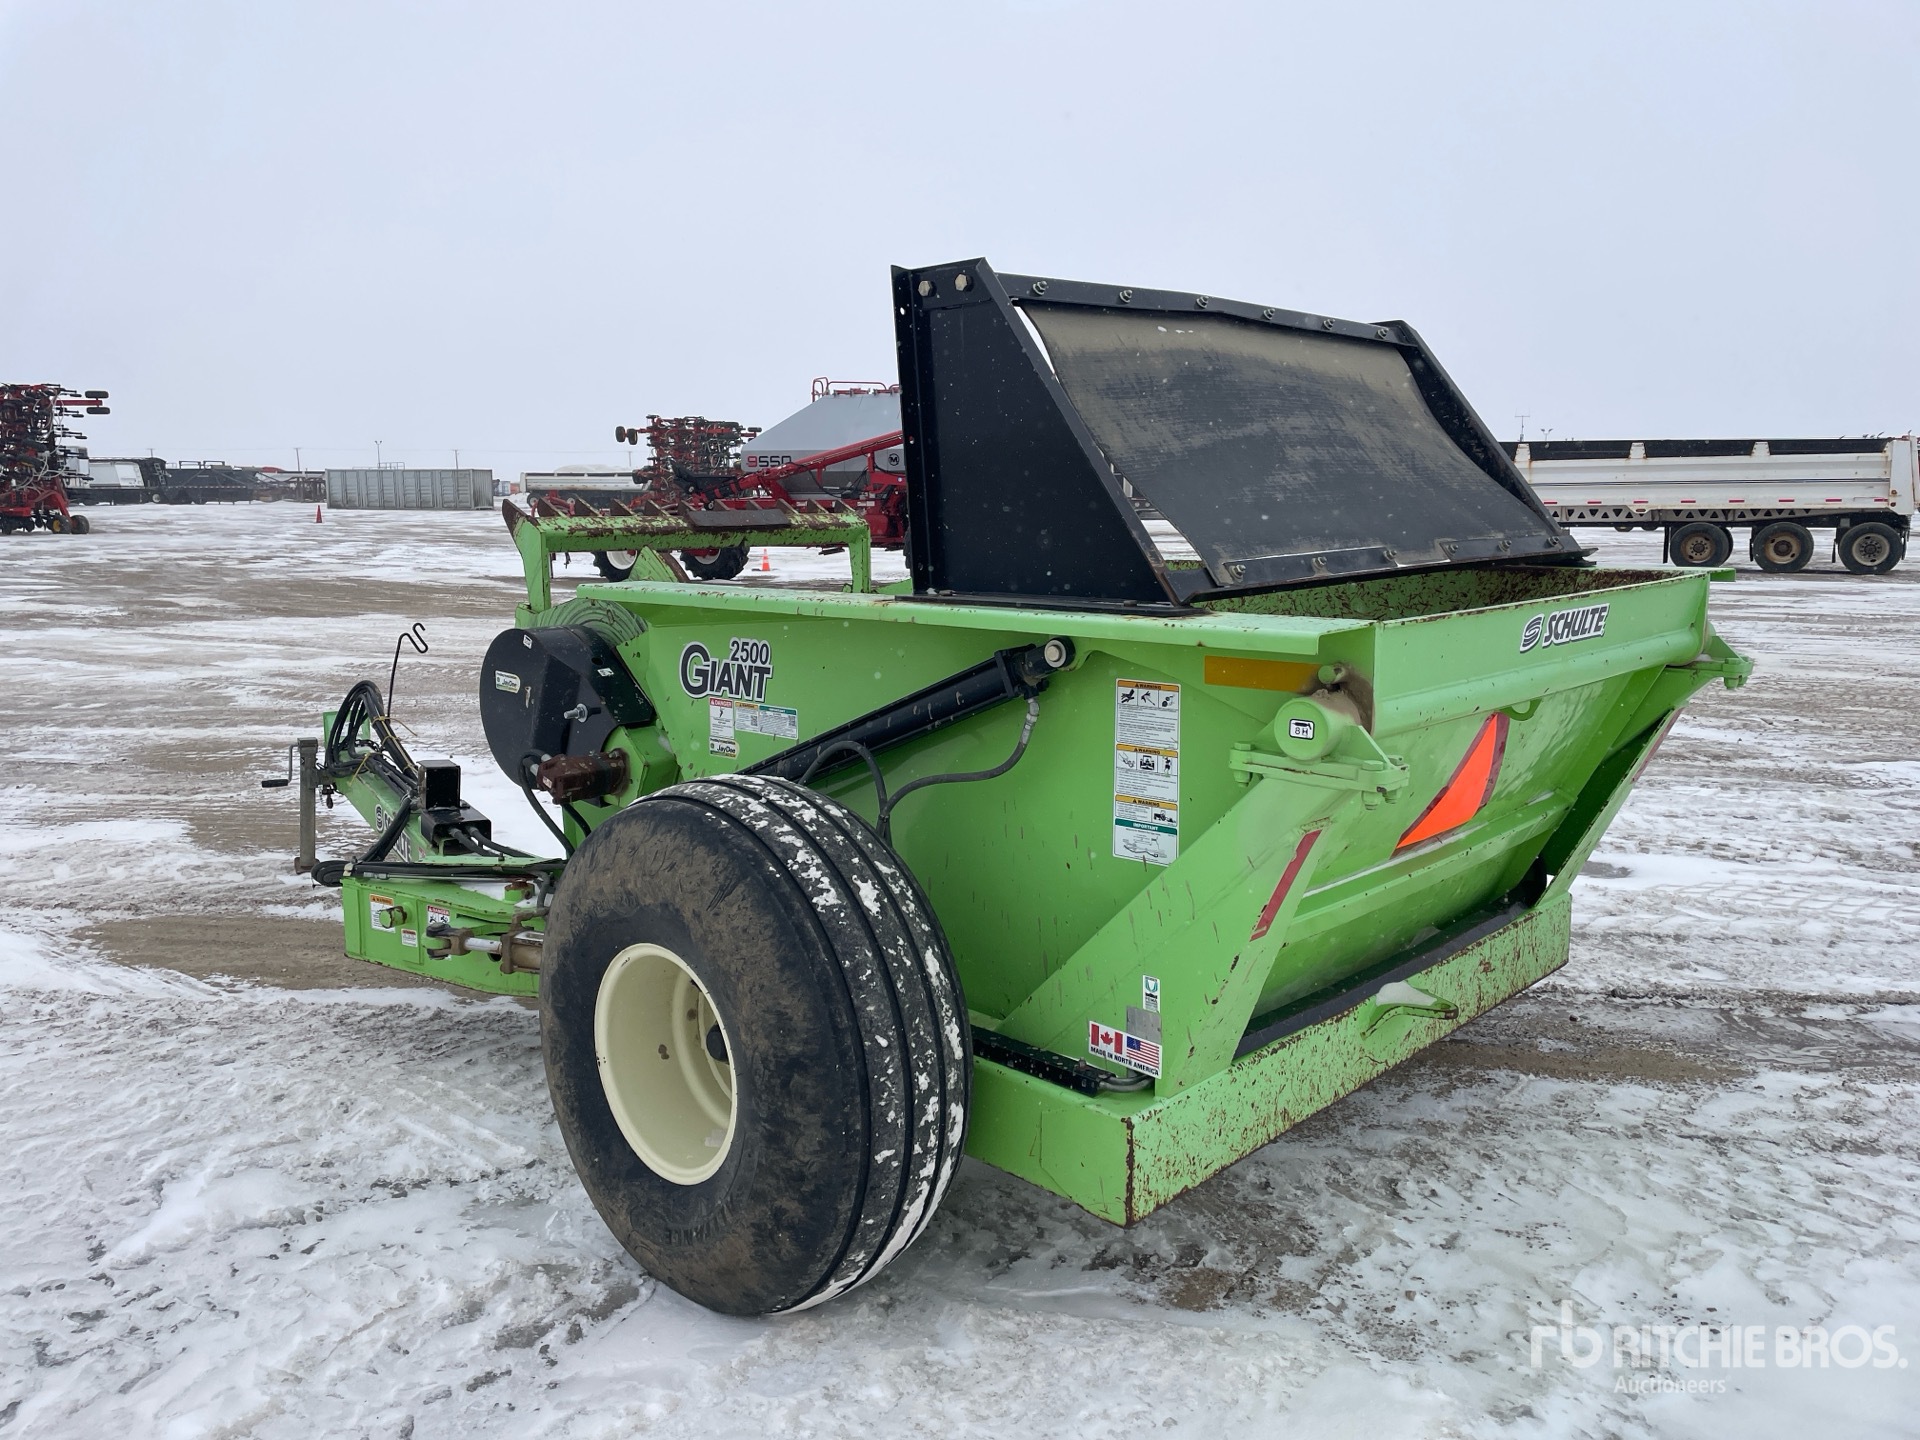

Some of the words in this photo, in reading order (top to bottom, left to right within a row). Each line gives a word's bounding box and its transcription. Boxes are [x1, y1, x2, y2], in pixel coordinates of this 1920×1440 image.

[1543, 606, 1608, 643] SCHULTE
[730, 640, 770, 665] 2500
[681, 644, 771, 698] GIANT
[1294, 727, 1301, 735] 8
[1137, 799, 1160, 807] WARNING
[1132, 823, 1159, 831] IMPORTANT
[1090, 1046, 1106, 1057] MADE
[1114, 1055, 1133, 1066] NORTH
[1133, 1061, 1159, 1076] AMERICA
